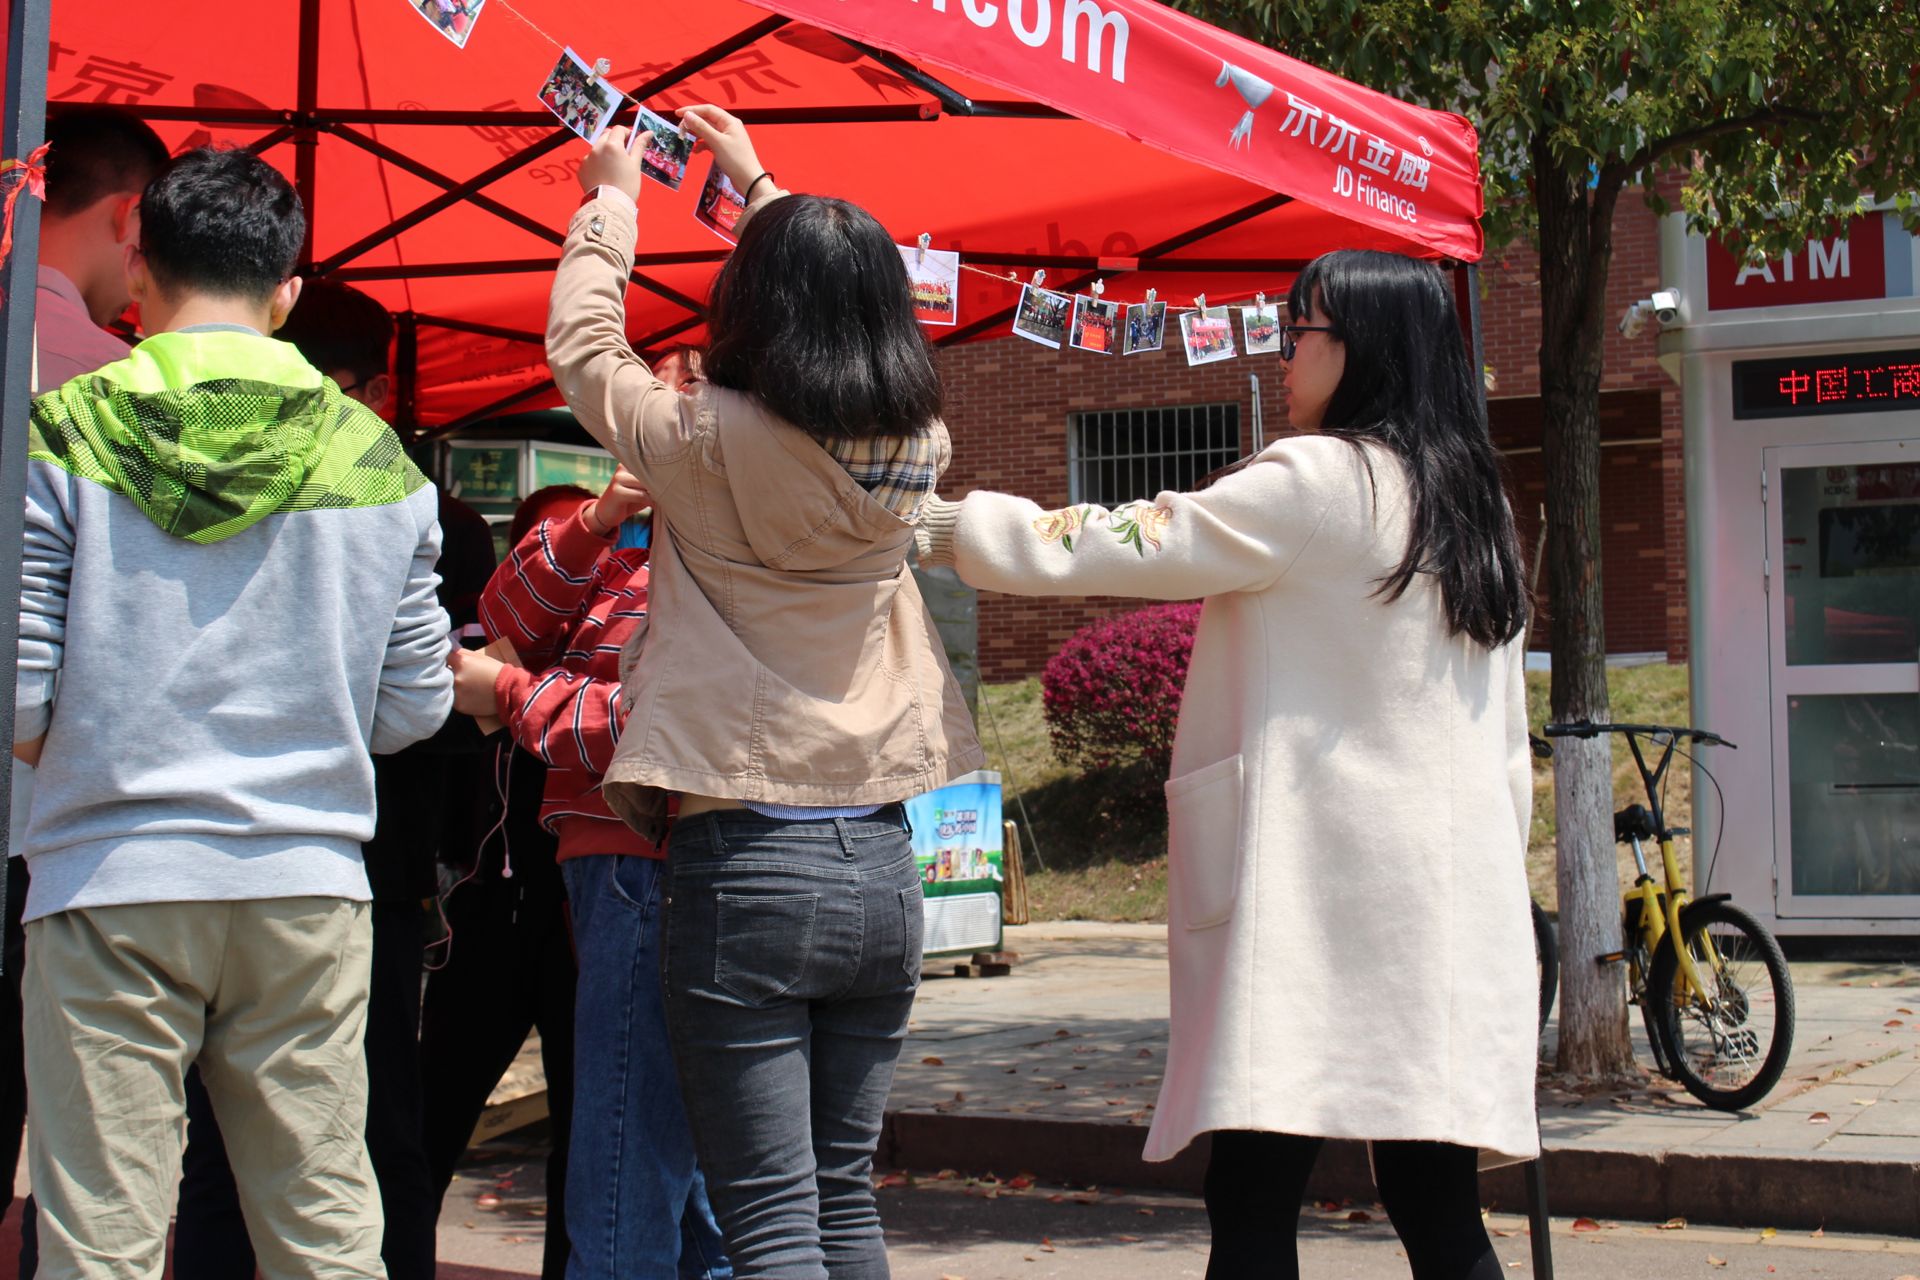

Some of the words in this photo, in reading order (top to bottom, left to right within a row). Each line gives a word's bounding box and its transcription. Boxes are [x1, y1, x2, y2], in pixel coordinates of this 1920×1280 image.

[1332, 164, 1353, 198] JD
[1357, 173, 1417, 223] Finance
[1779, 365, 1920, 405] 中国工商
